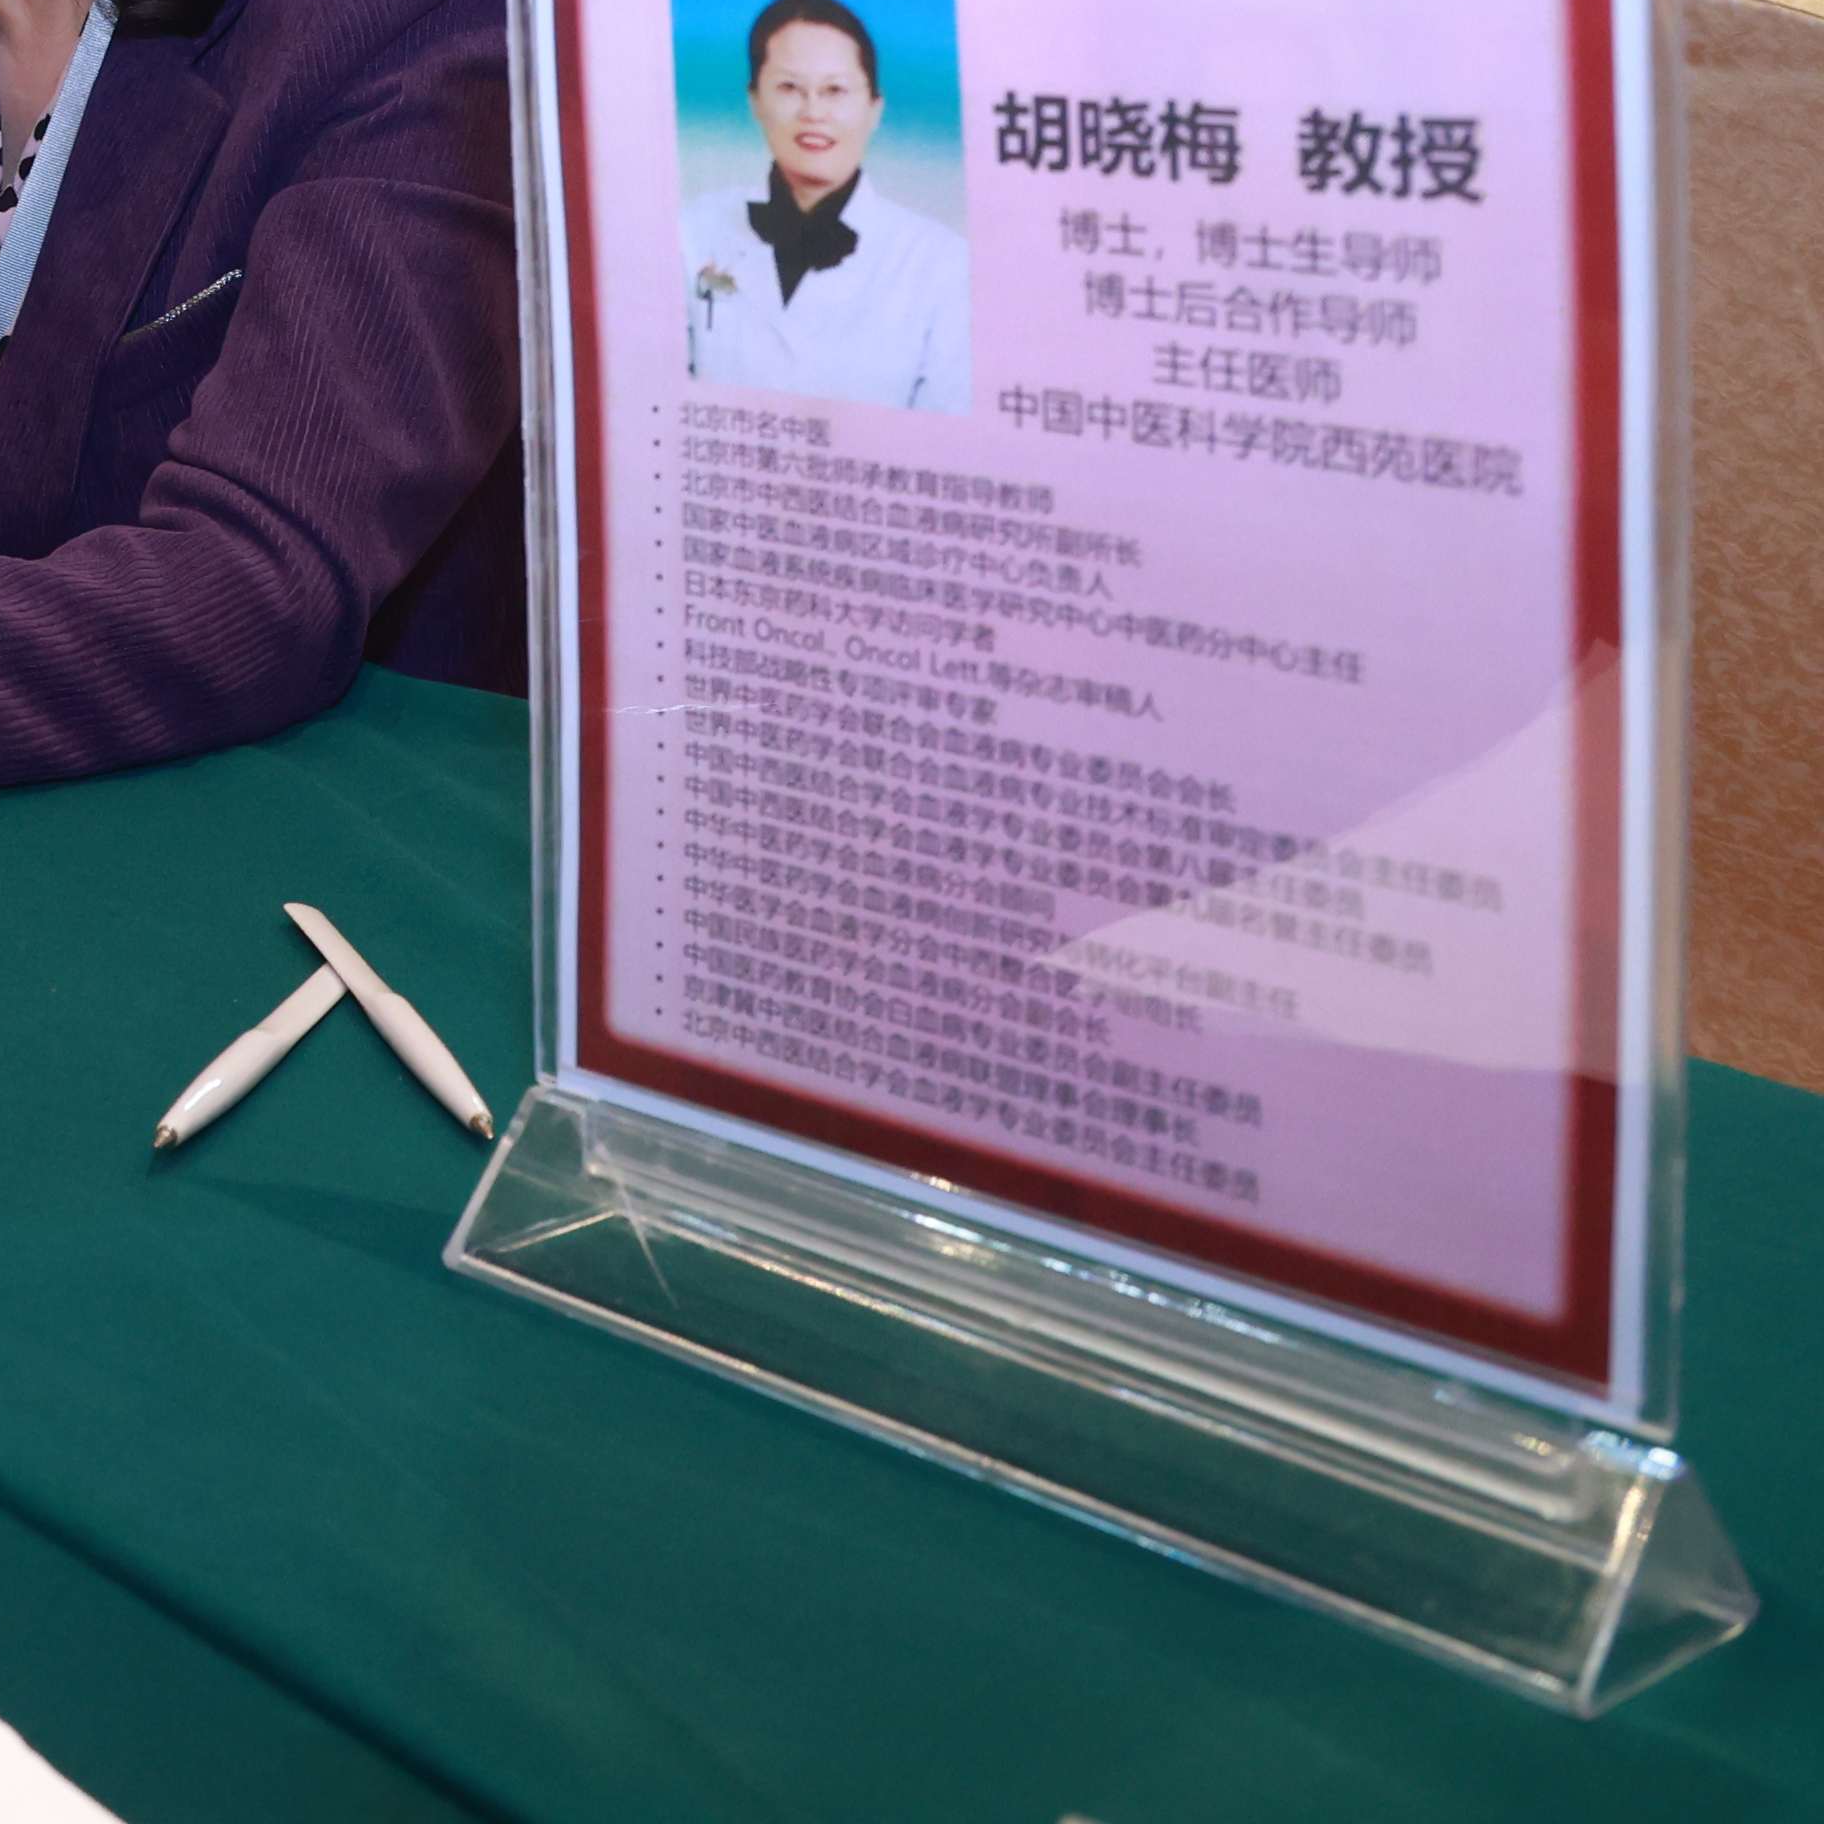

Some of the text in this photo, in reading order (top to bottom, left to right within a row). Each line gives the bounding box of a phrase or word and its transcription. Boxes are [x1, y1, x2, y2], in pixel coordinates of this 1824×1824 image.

[993, 91, 1484, 204] 胡晓梅 教授
[1084, 269, 1419, 349] 博士后合作导师
[1152, 340, 1342, 406] 主任医师
[678, 401, 833, 448] 北京市名中医
[998, 385, 1525, 499] 中国中医科学院西苑医院
[684, 603, 746, 641] Front
[844, 634, 922, 672] Oncol
